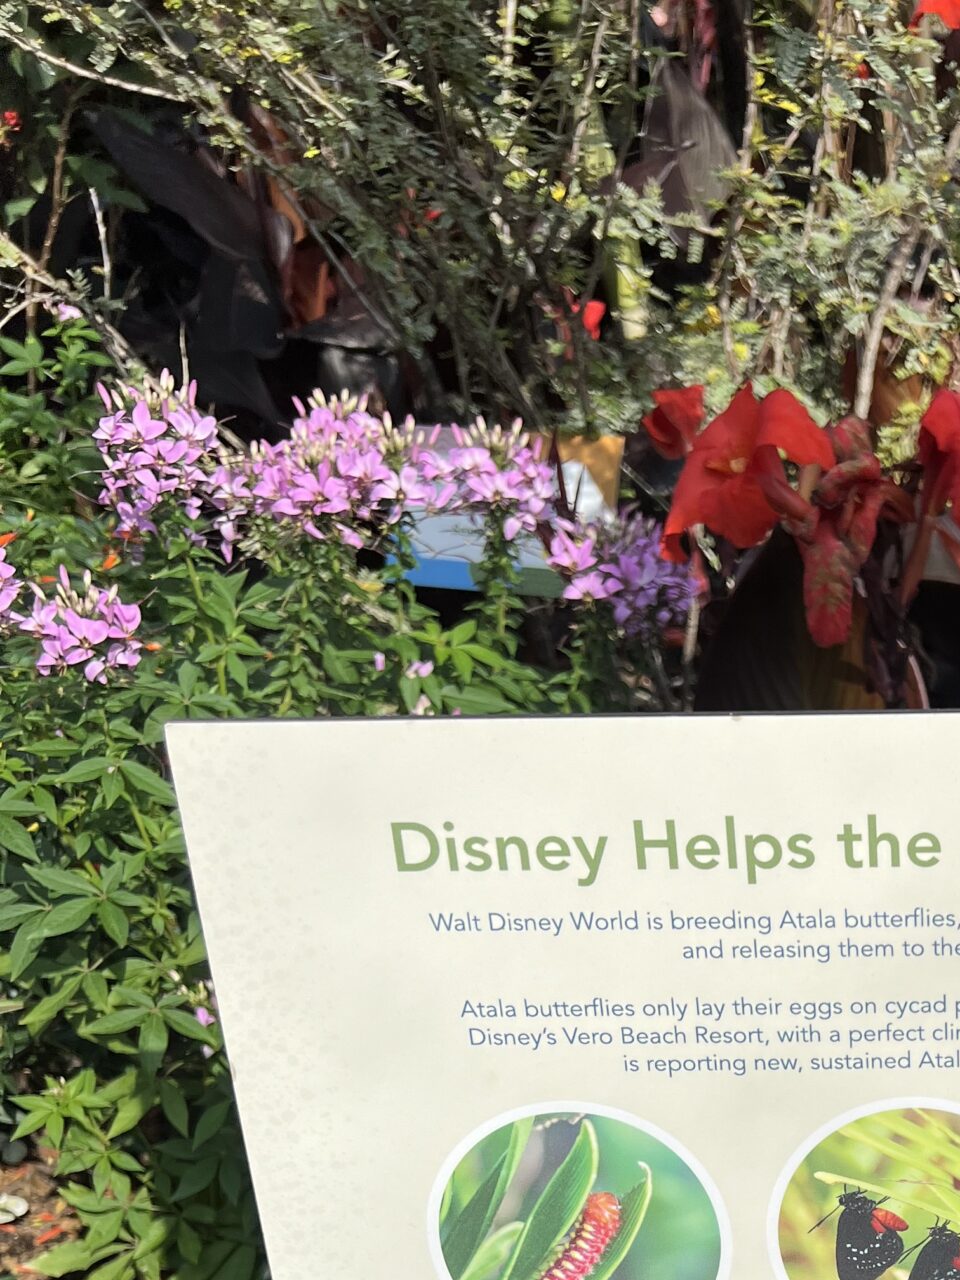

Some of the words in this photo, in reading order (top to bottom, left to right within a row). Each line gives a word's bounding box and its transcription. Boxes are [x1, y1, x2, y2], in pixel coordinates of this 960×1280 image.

[391, 821, 608, 887] Disney
[633, 816, 815, 884] Helps
[837, 814, 941, 868] the
[428, 912, 482, 932] Walt
[488, 912, 563, 936] Disney
[569, 910, 639, 931] World
[647, 912, 663, 930] is
[670, 909, 771, 935] breeding
[779, 908, 836, 929] Atala
[683, 939, 723, 959] and
[732, 938, 830, 963] releasing
[838, 938, 894, 957] them
[902, 941, 924, 957] to
[461, 998, 517, 1018] Atala
[524, 997, 635, 1017] butterflies
[643, 997, 687, 1021] only
[696, 997, 725, 1021] lay
[732, 996, 782, 1016] their
[789, 1002, 843, 1020] eggs
[850, 1001, 876, 1014] on
[885, 994, 947, 1019] cycad
[563, 1027, 613, 1046] Vero
[621, 1025, 686, 1045] Beach
[695, 1026, 769, 1046] Resort,
[777, 1025, 821, 1044] with
[829, 1030, 841, 1043] a
[849, 1023, 925, 1048] perfect
[624, 1055, 639, 1072] is
[647, 1054, 746, 1078] reporting
[754, 1058, 802, 1074] new,
[811, 1051, 911, 1070] sustained
